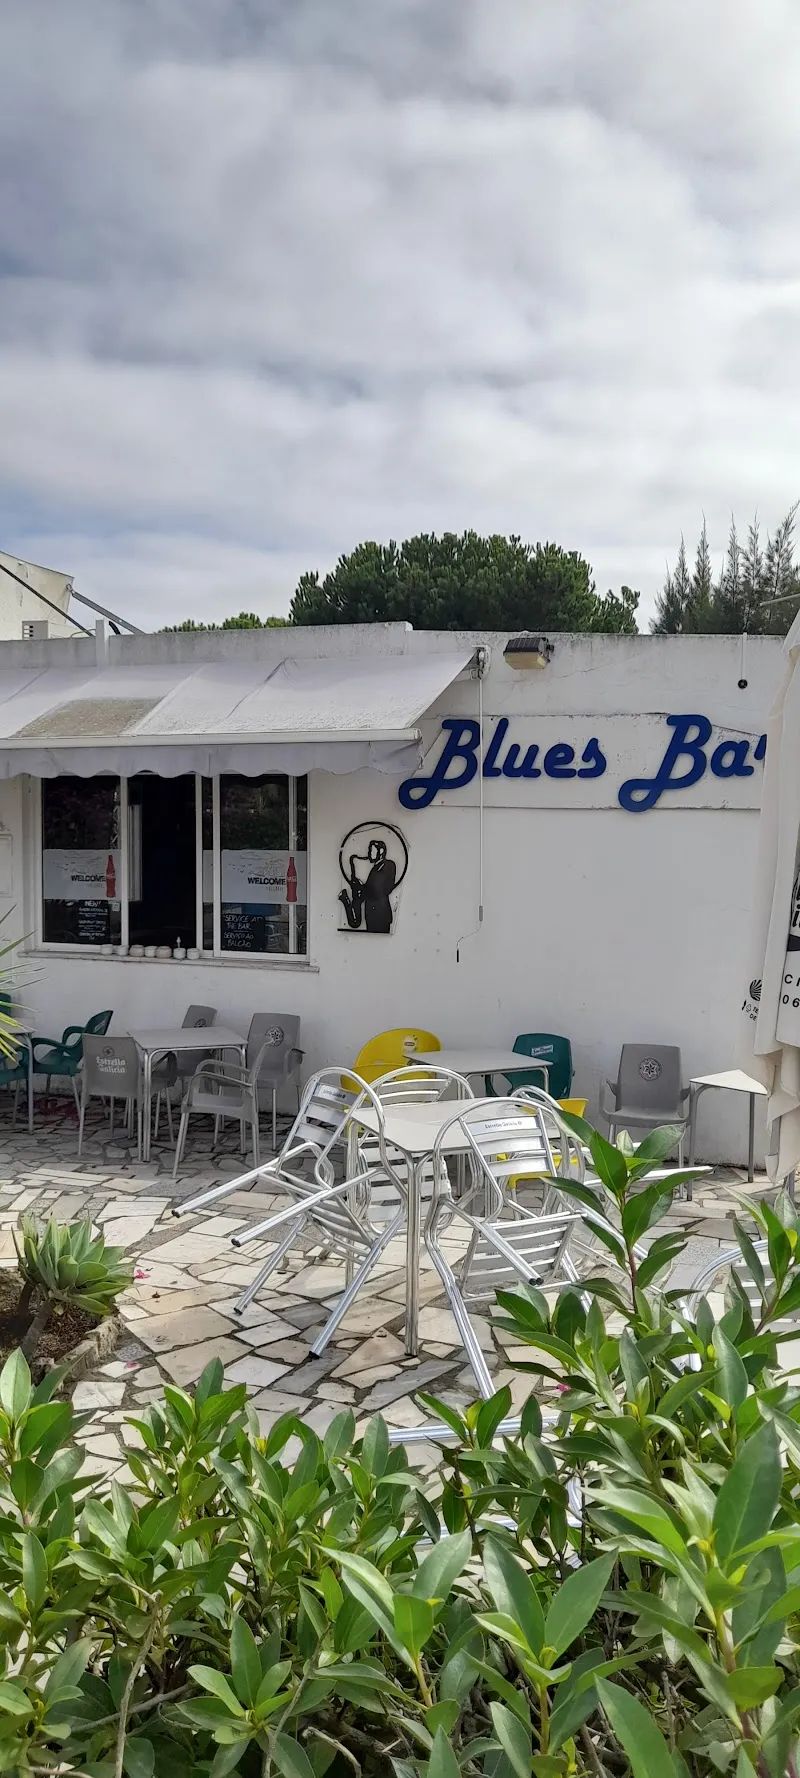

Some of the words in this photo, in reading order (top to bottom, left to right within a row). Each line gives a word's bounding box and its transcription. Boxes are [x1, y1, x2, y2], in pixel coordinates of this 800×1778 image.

[398, 718, 607, 810] Blues
[70, 874, 106, 882] WELCOME
[247, 877, 286, 886] WELCOME
